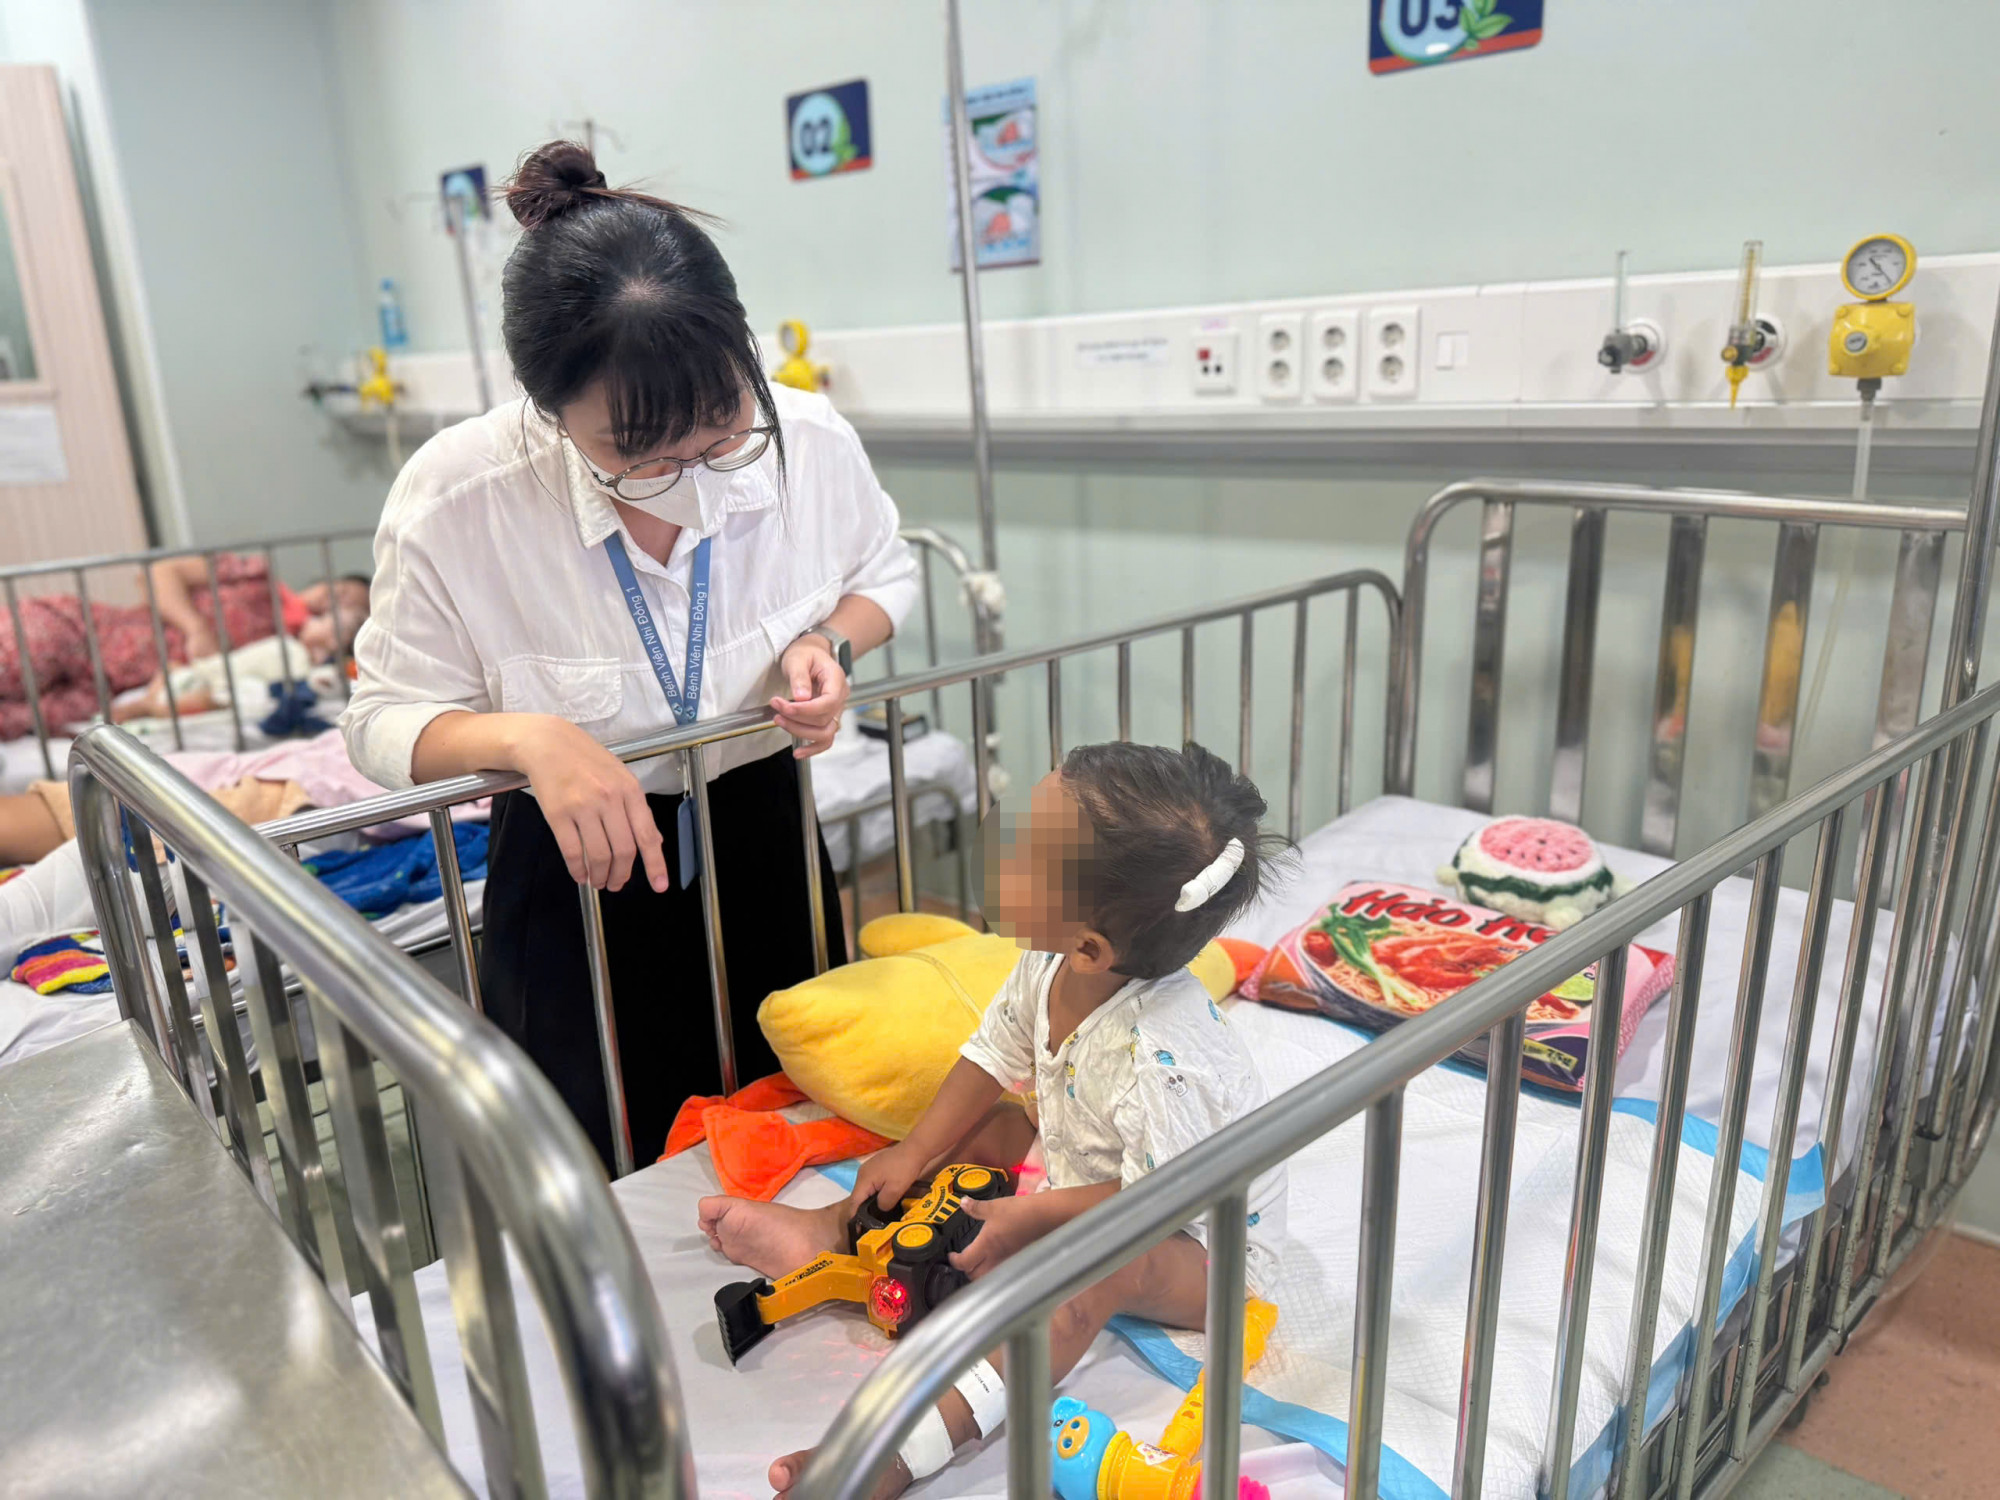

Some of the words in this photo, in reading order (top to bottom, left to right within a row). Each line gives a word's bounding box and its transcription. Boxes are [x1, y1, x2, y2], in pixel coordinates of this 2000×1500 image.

[800, 115, 833, 157] 02
[642, 626, 657, 646] Nhi
[691, 624, 703, 643] Nhi
[689, 645, 701, 670] Viện
[687, 672, 699, 699] Bệnh
